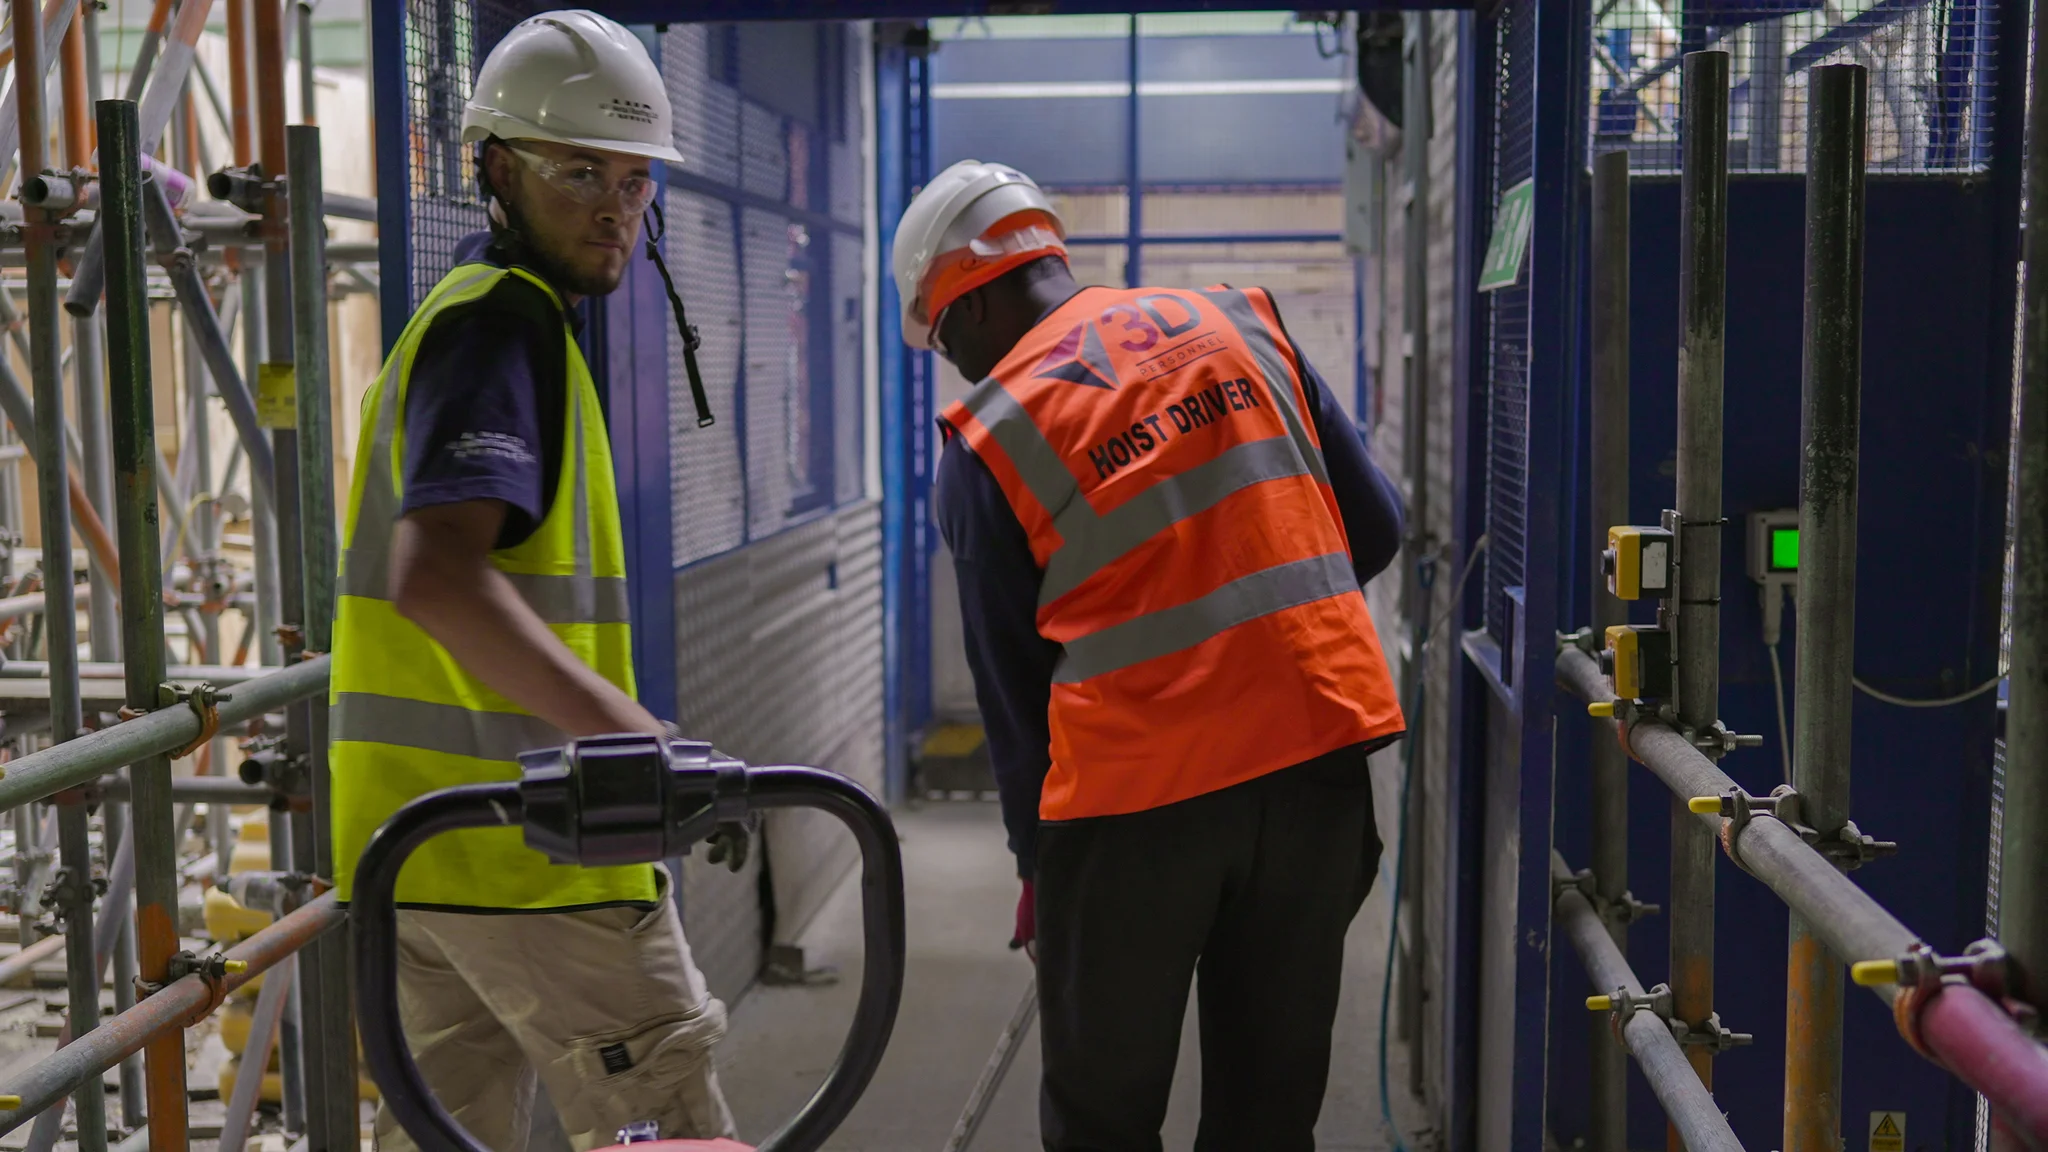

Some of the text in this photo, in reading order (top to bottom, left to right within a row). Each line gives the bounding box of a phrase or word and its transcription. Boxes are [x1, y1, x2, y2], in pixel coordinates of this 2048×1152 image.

[1101, 294, 1202, 352] 3D
[1139, 336, 1225, 376] PERSONNEL
[1088, 377, 1259, 480] HOIST DRIVER
